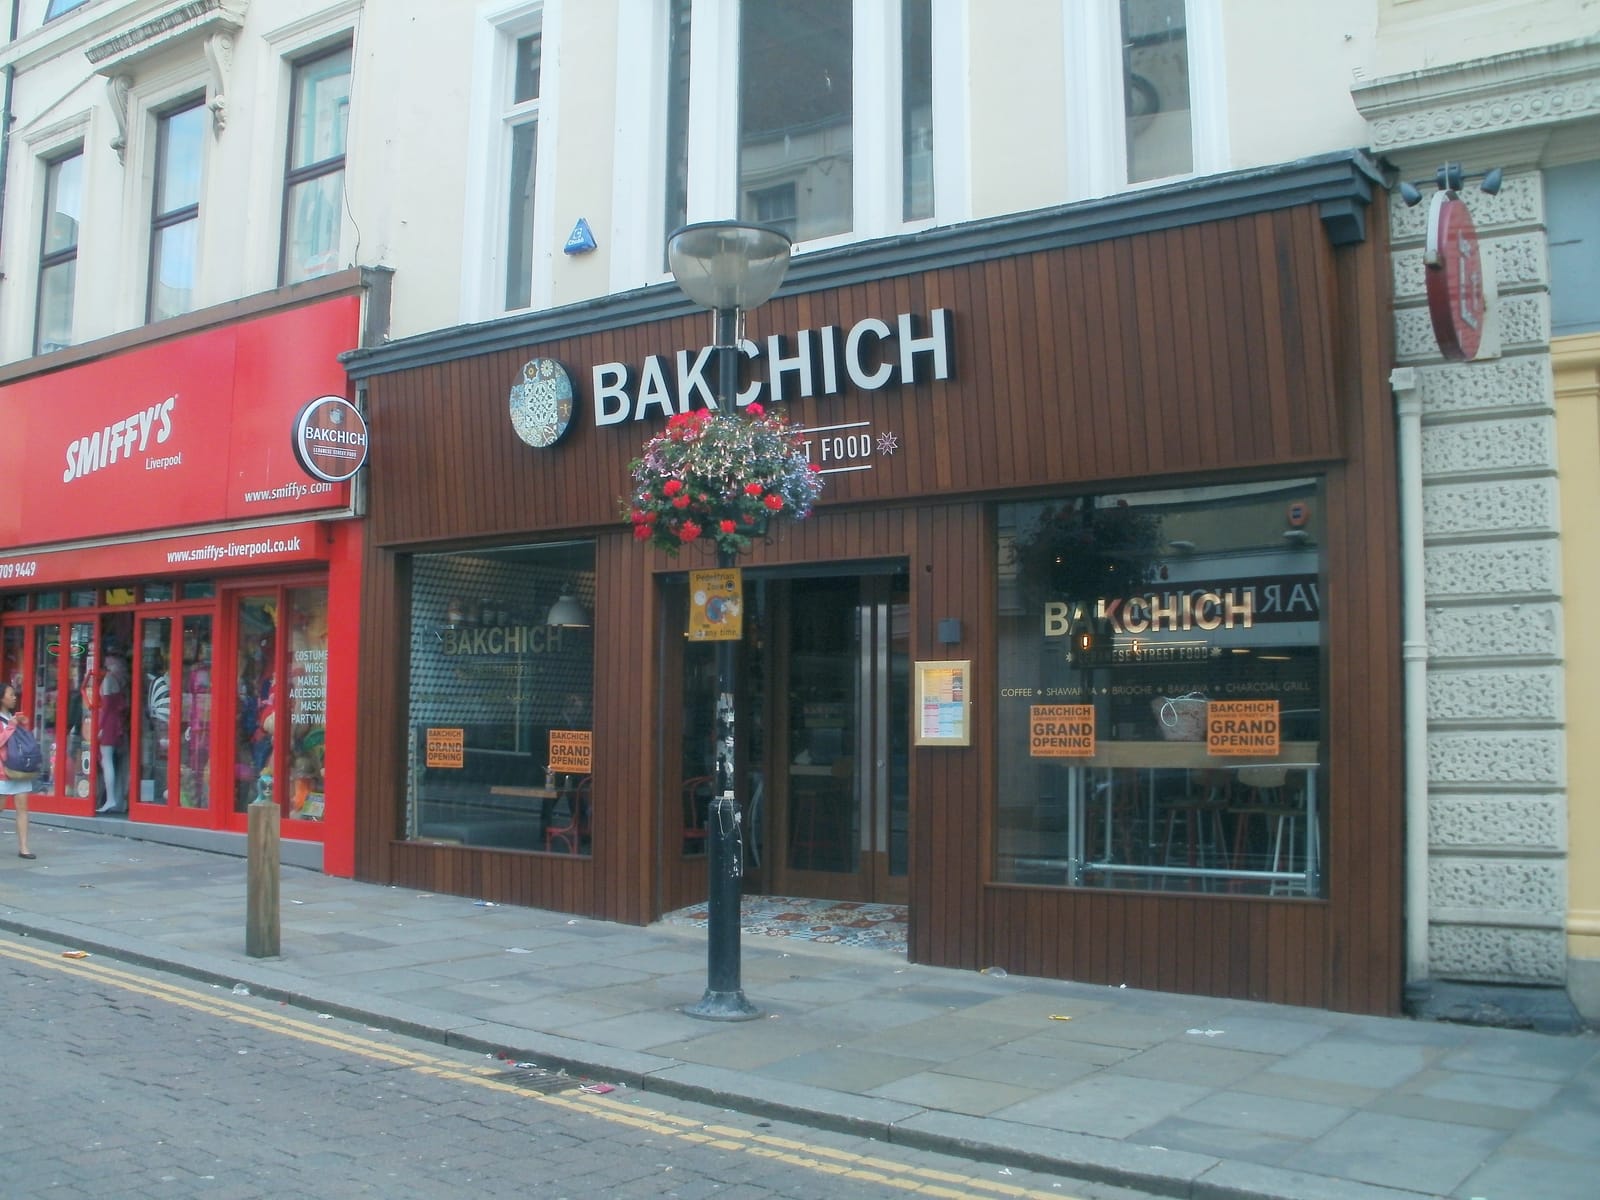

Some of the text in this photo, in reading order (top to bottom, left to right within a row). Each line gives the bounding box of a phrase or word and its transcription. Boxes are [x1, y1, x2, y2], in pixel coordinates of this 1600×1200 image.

[592, 308, 948, 426] BAKCHICH
[63, 397, 174, 483] SMIFFY'S
[305, 426, 365, 446] BAKCHICH
[821, 434, 871, 461] FOOD
[145, 451, 181, 470] Liverpool
[244, 482, 332, 502] www.smiffys.com
[167, 536, 301, 562] www.smiffys-liverpool.co.uk
[15, 561, 36, 577] 9449
[1179, 646, 1208, 659] FOOD
[304, 662, 324, 672] WIGS
[297, 675, 319, 686] MAKE
[1001, 688, 1033, 697] COFFEE
[1046, 687, 1098, 696] SHAWARA
[1033, 707, 1091, 716] BAKCHICH
[1210, 704, 1275, 713] BAKCHICH
[1033, 723, 1093, 736] GRAND
[1210, 720, 1277, 734] GRAND
[551, 732, 590, 740] BAKCHICH
[1032, 737, 1091, 748] OPENING
[1210, 735, 1276, 746] OPENING
[551, 745, 591, 757] GRAND
[551, 756, 590, 766] OPENING
